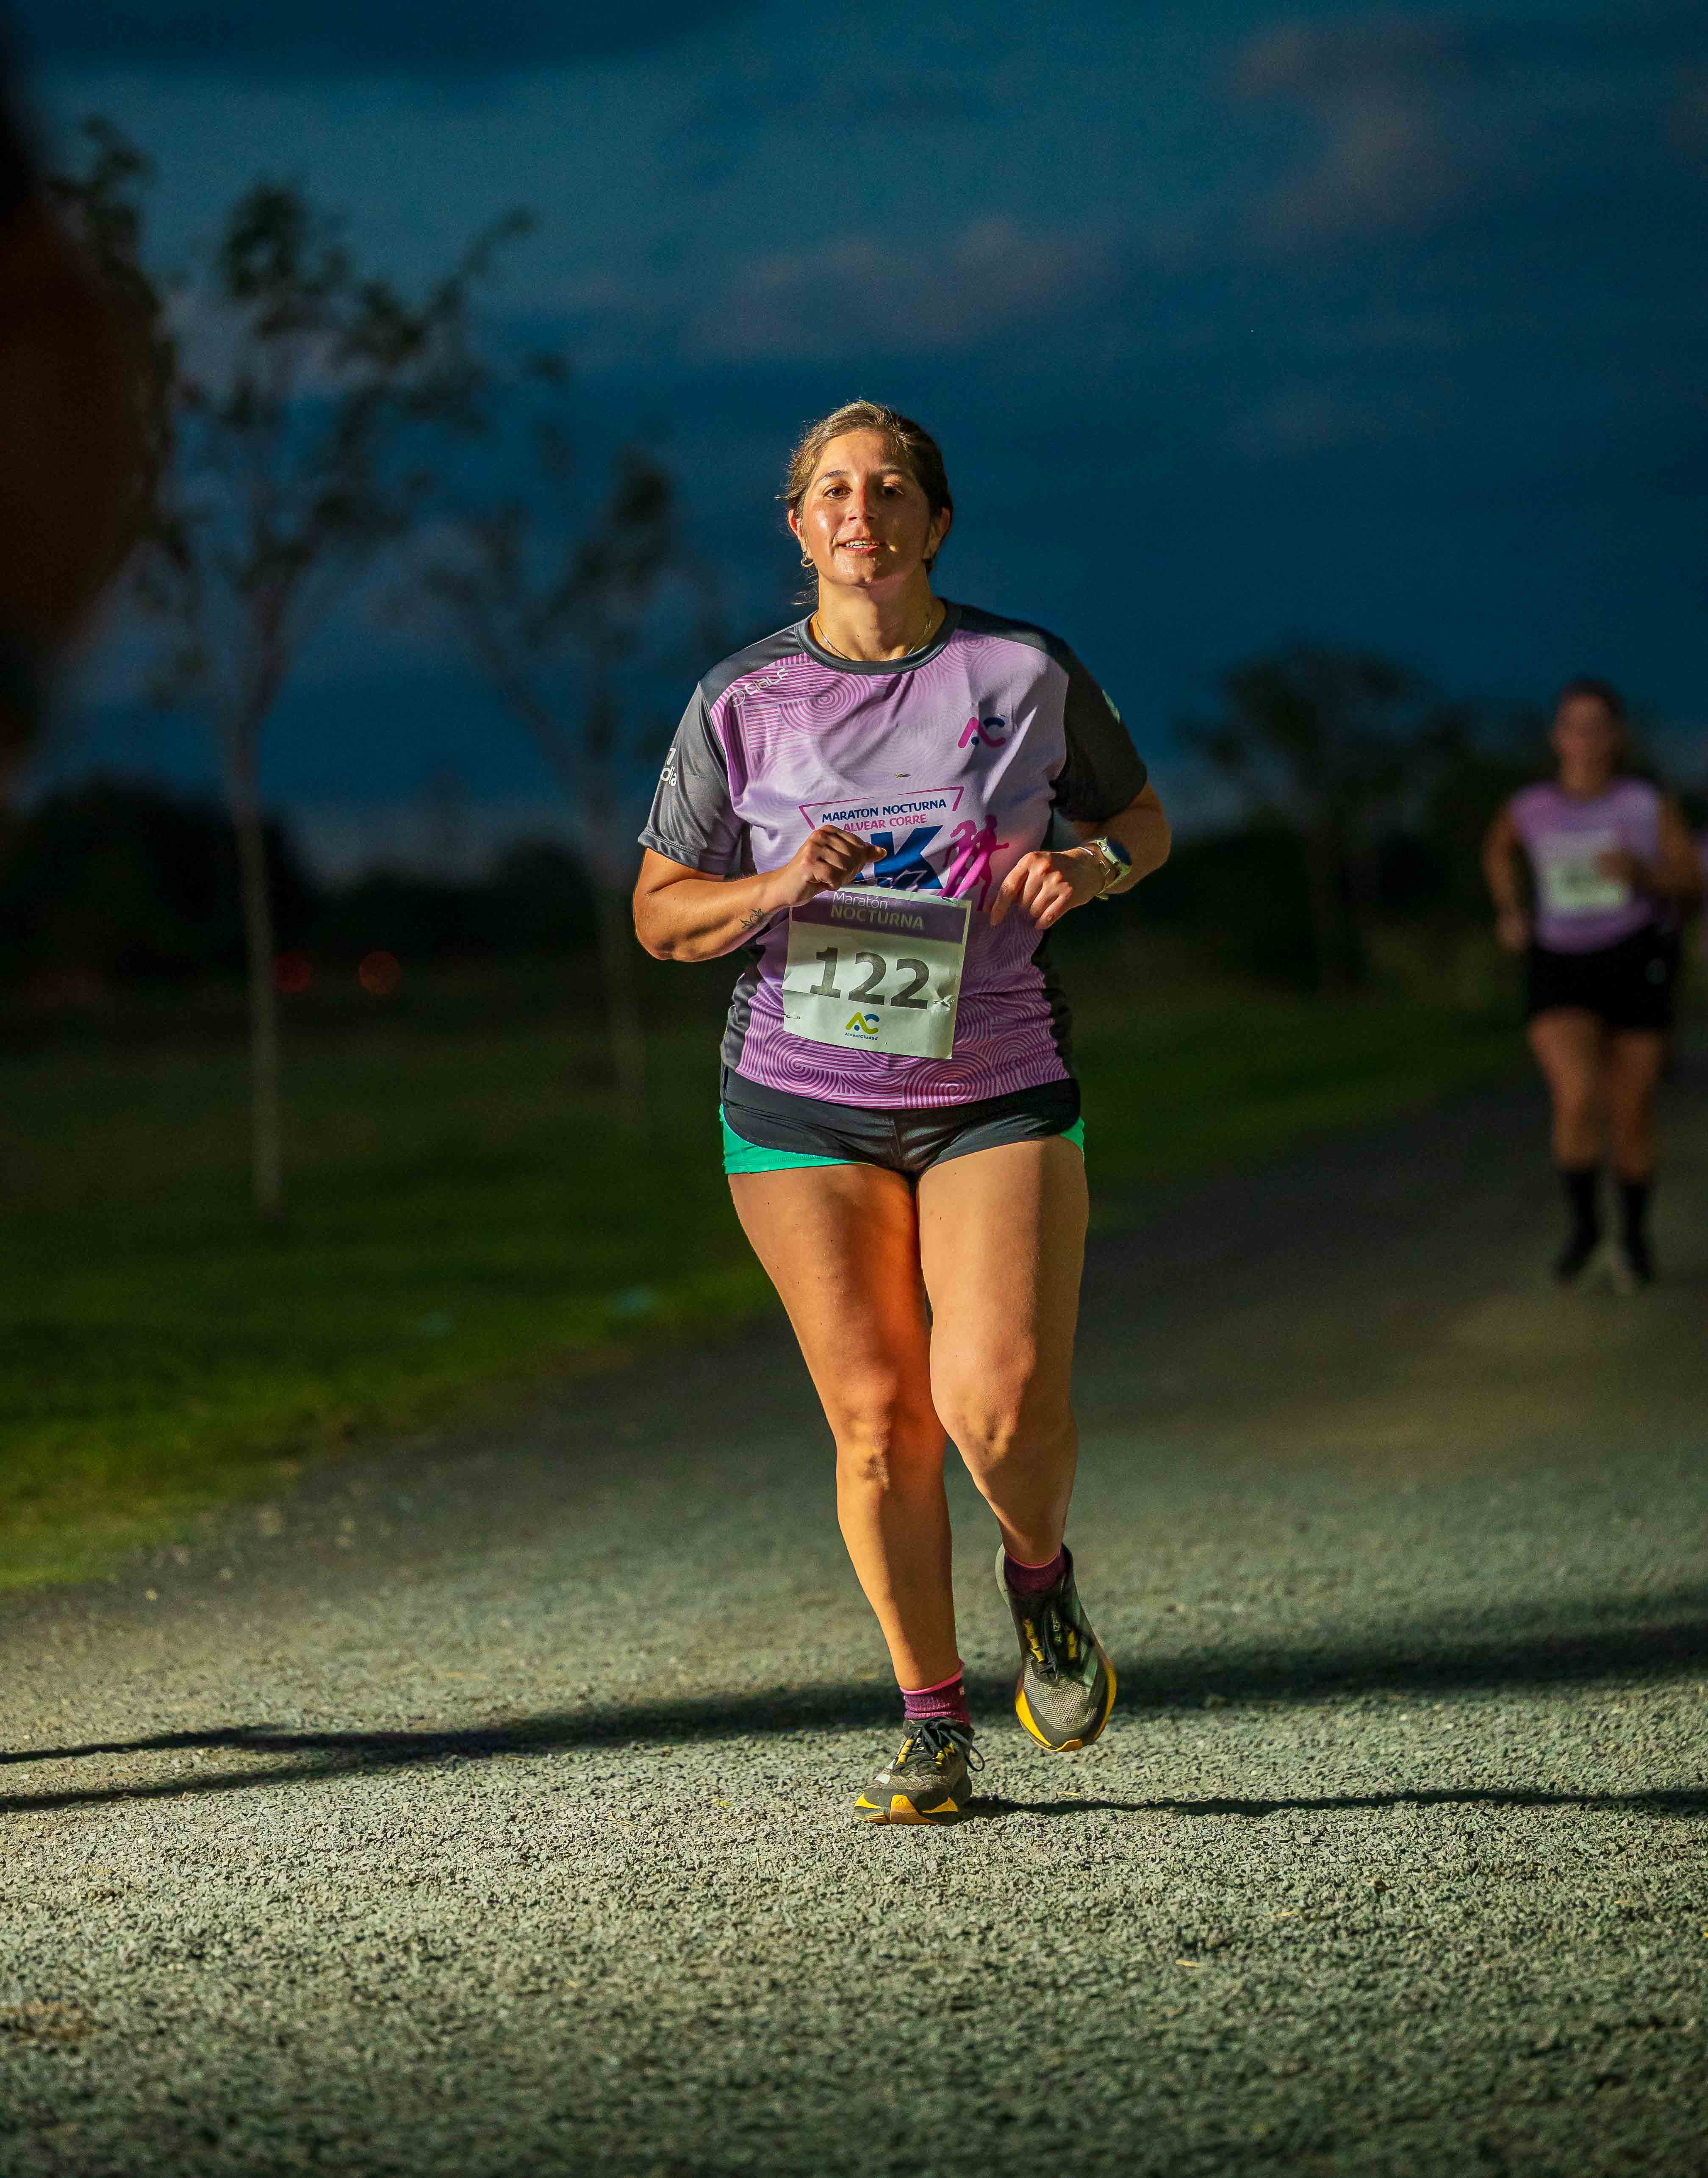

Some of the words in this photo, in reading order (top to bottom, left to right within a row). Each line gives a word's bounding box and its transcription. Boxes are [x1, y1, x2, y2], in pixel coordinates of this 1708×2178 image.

[822, 807, 879, 823] MARATON
[883, 799, 947, 815] NOCTURNA
[843, 819, 886, 832] ALVEAR
[890, 814, 927, 827] CORRE
[833, 891, 887, 910] Maratón
[831, 904, 923, 929] NOCTURNA
[810, 947, 929, 1009] 122
[844, 1032, 878, 1040] AlvearCiudad
